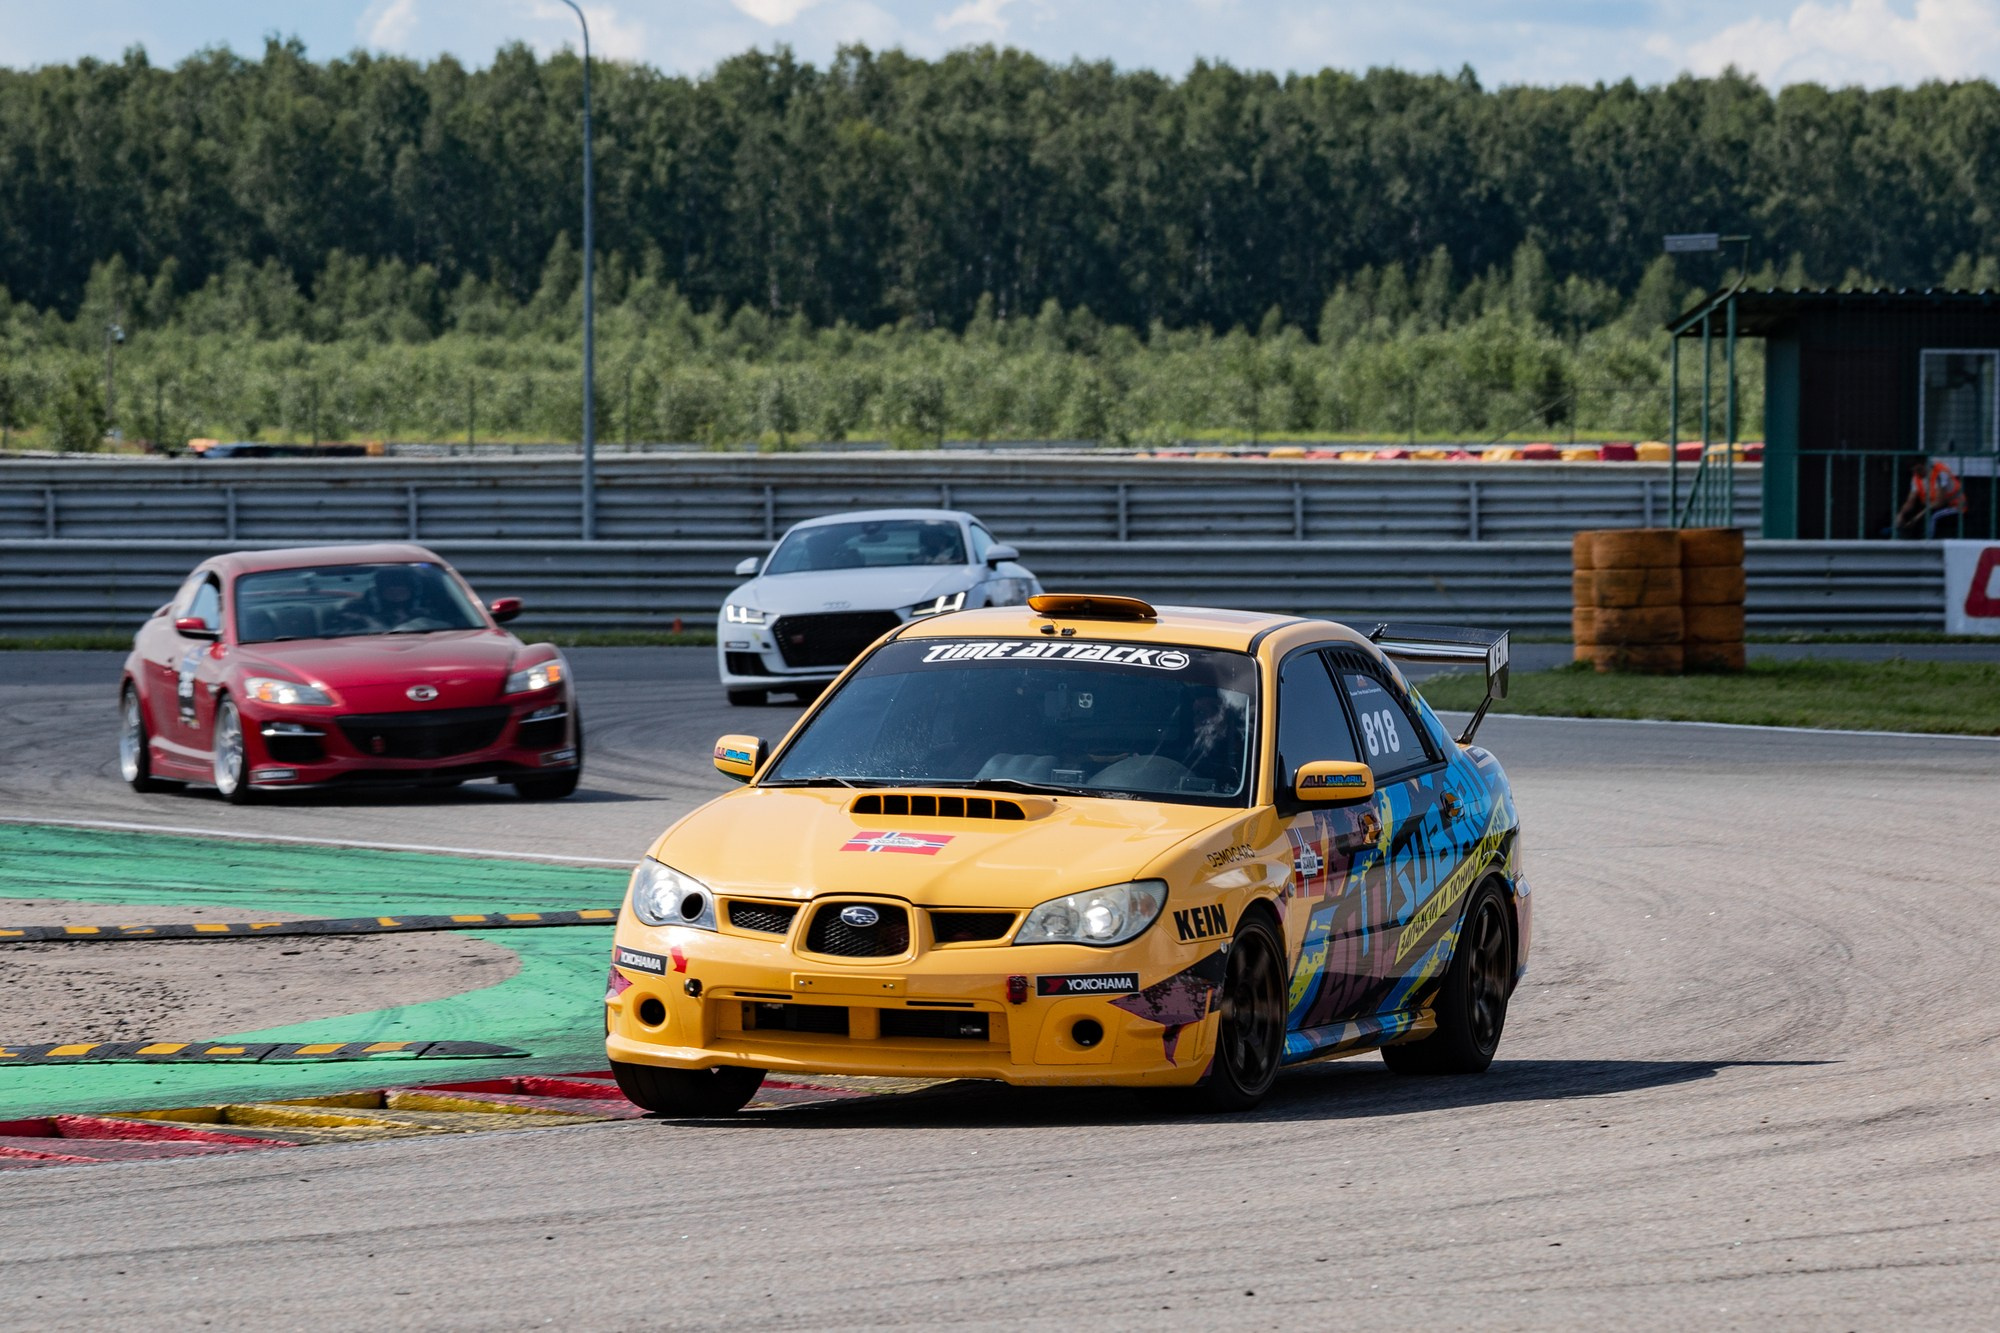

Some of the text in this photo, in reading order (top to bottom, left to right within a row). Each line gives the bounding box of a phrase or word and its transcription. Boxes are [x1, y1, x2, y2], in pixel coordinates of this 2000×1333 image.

[1489, 633, 1509, 677] KEIN
[1361, 709, 1400, 756] 818
[1326, 775, 1362, 784] SUBARU
[1206, 843, 1256, 868] DEMOCARS
[1173, 903, 1228, 941] KEIN
[1066, 977, 1133, 991] YOKOHAMA
